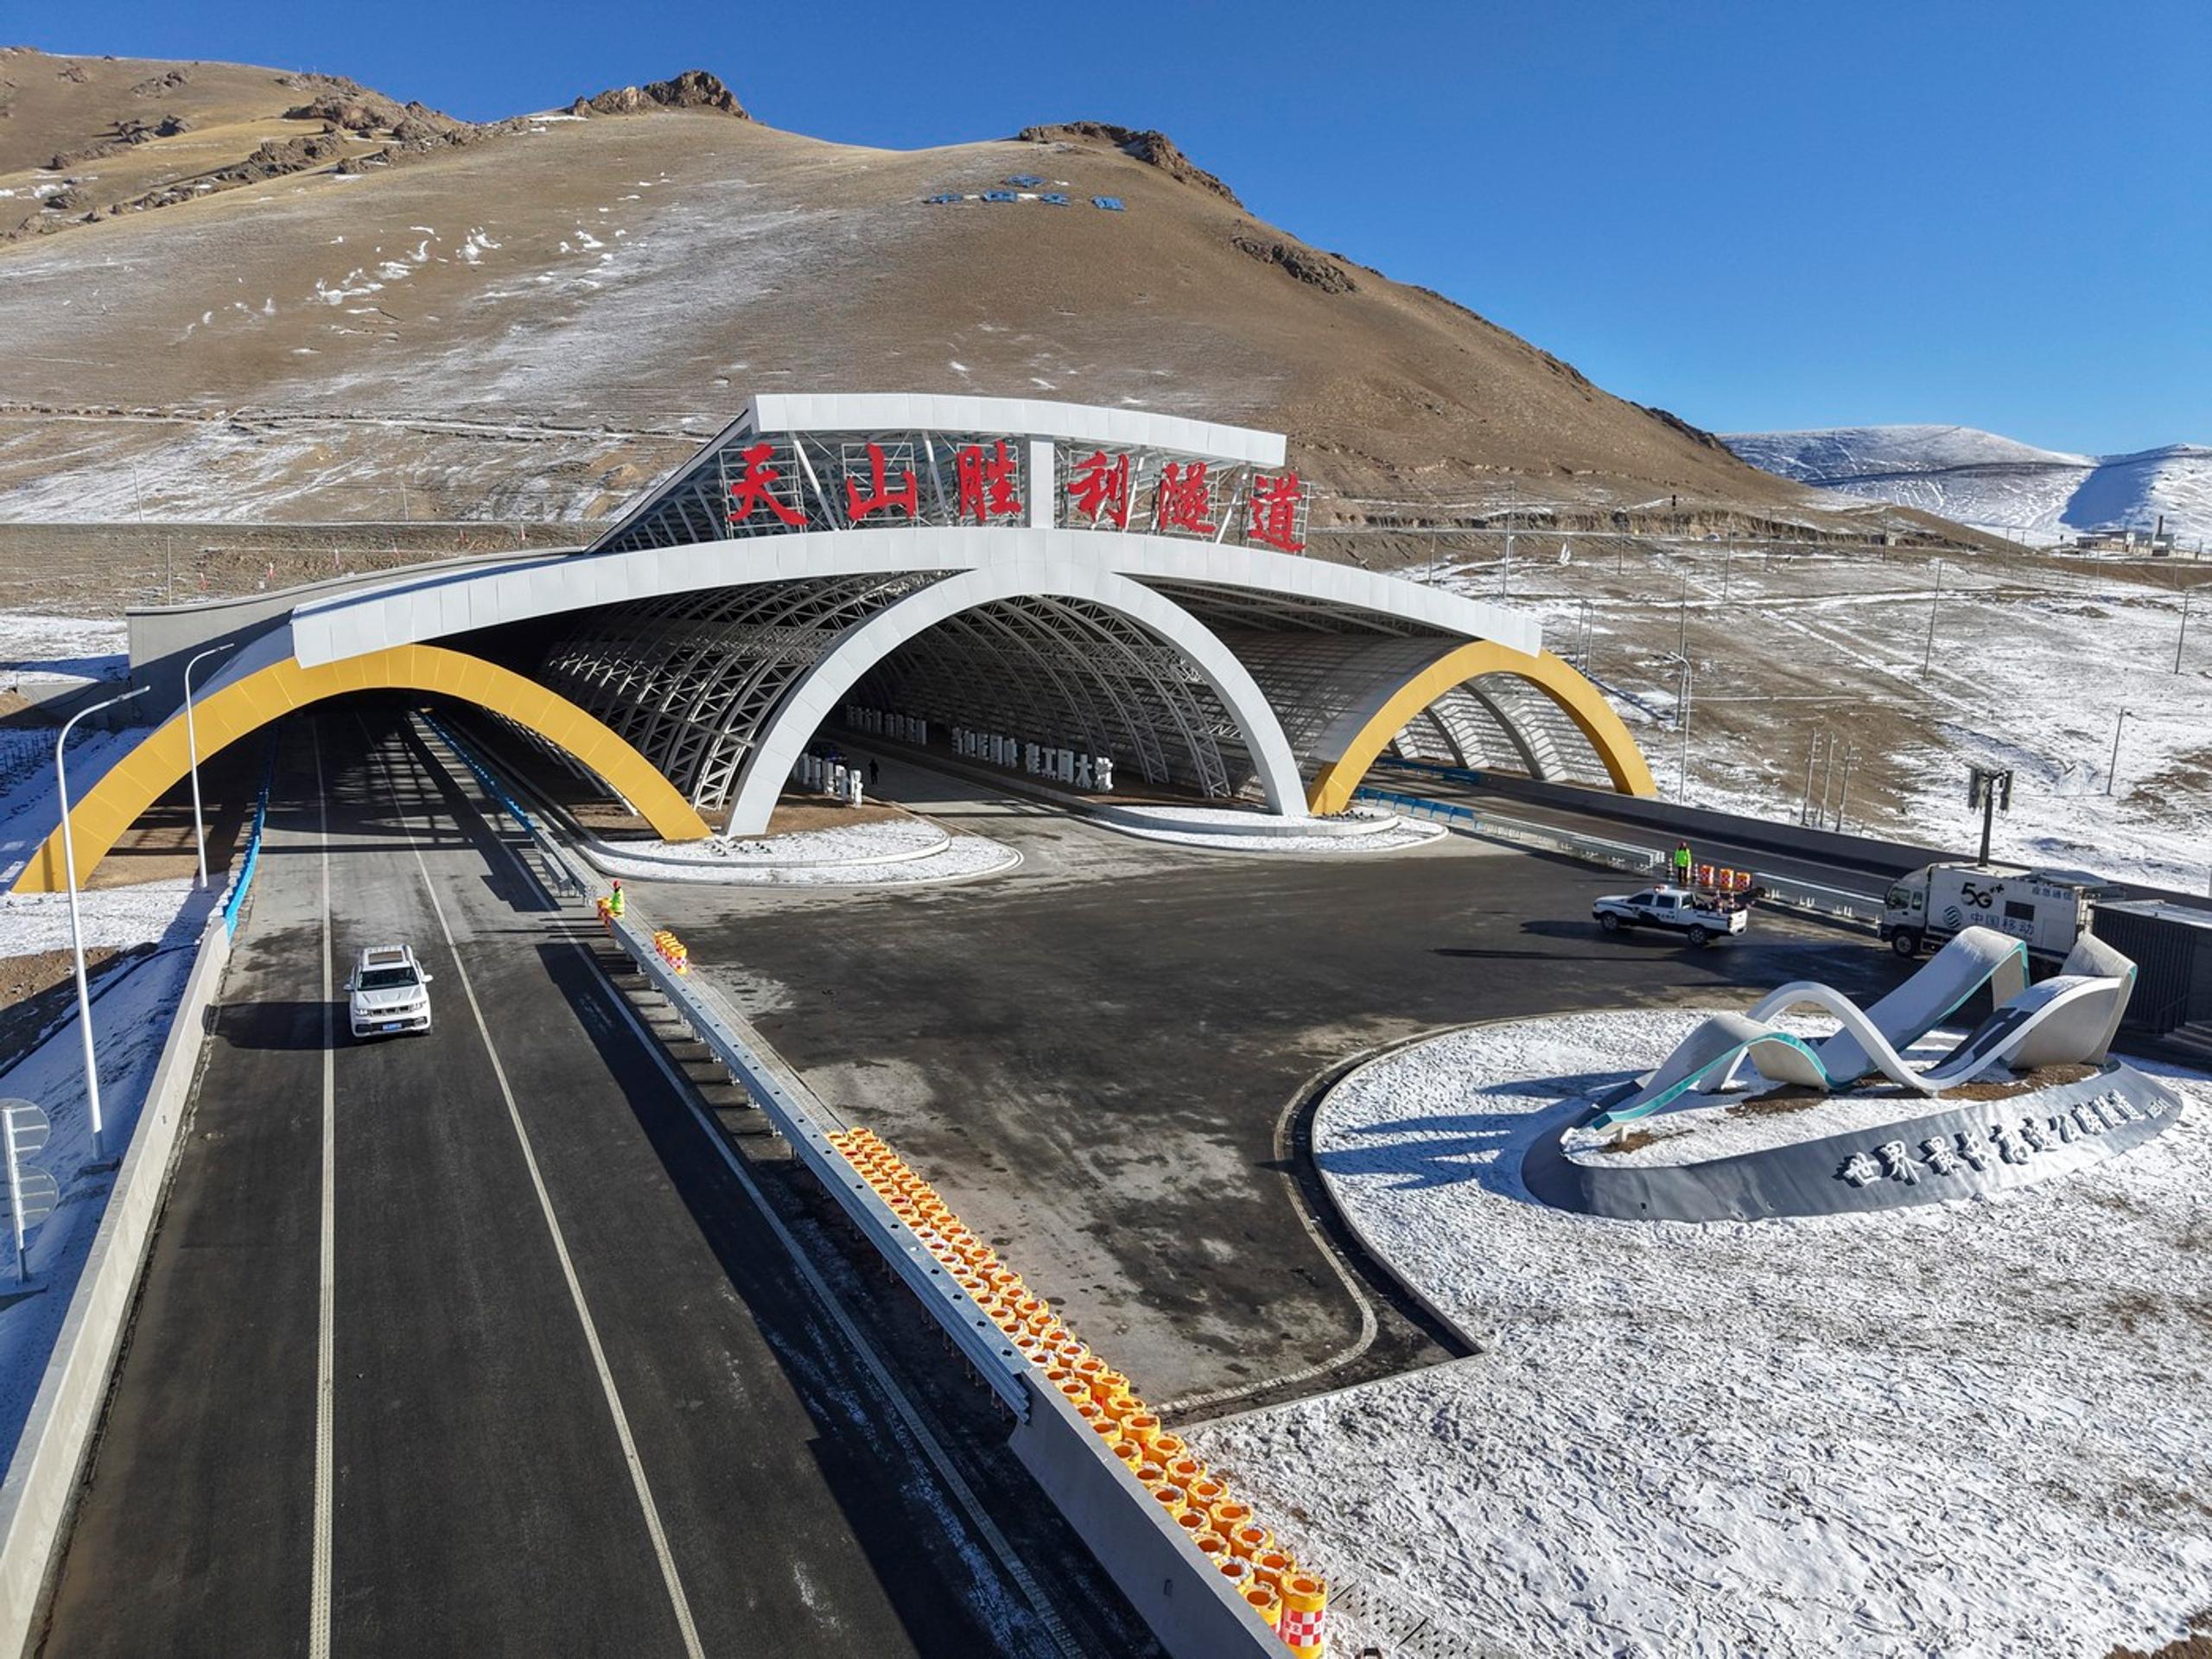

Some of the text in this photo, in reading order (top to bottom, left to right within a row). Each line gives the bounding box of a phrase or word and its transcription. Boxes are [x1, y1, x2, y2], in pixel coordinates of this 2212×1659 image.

[728, 441, 1306, 552] 天山胜利隧道
[1971, 912, 2034, 935] 中国移动
